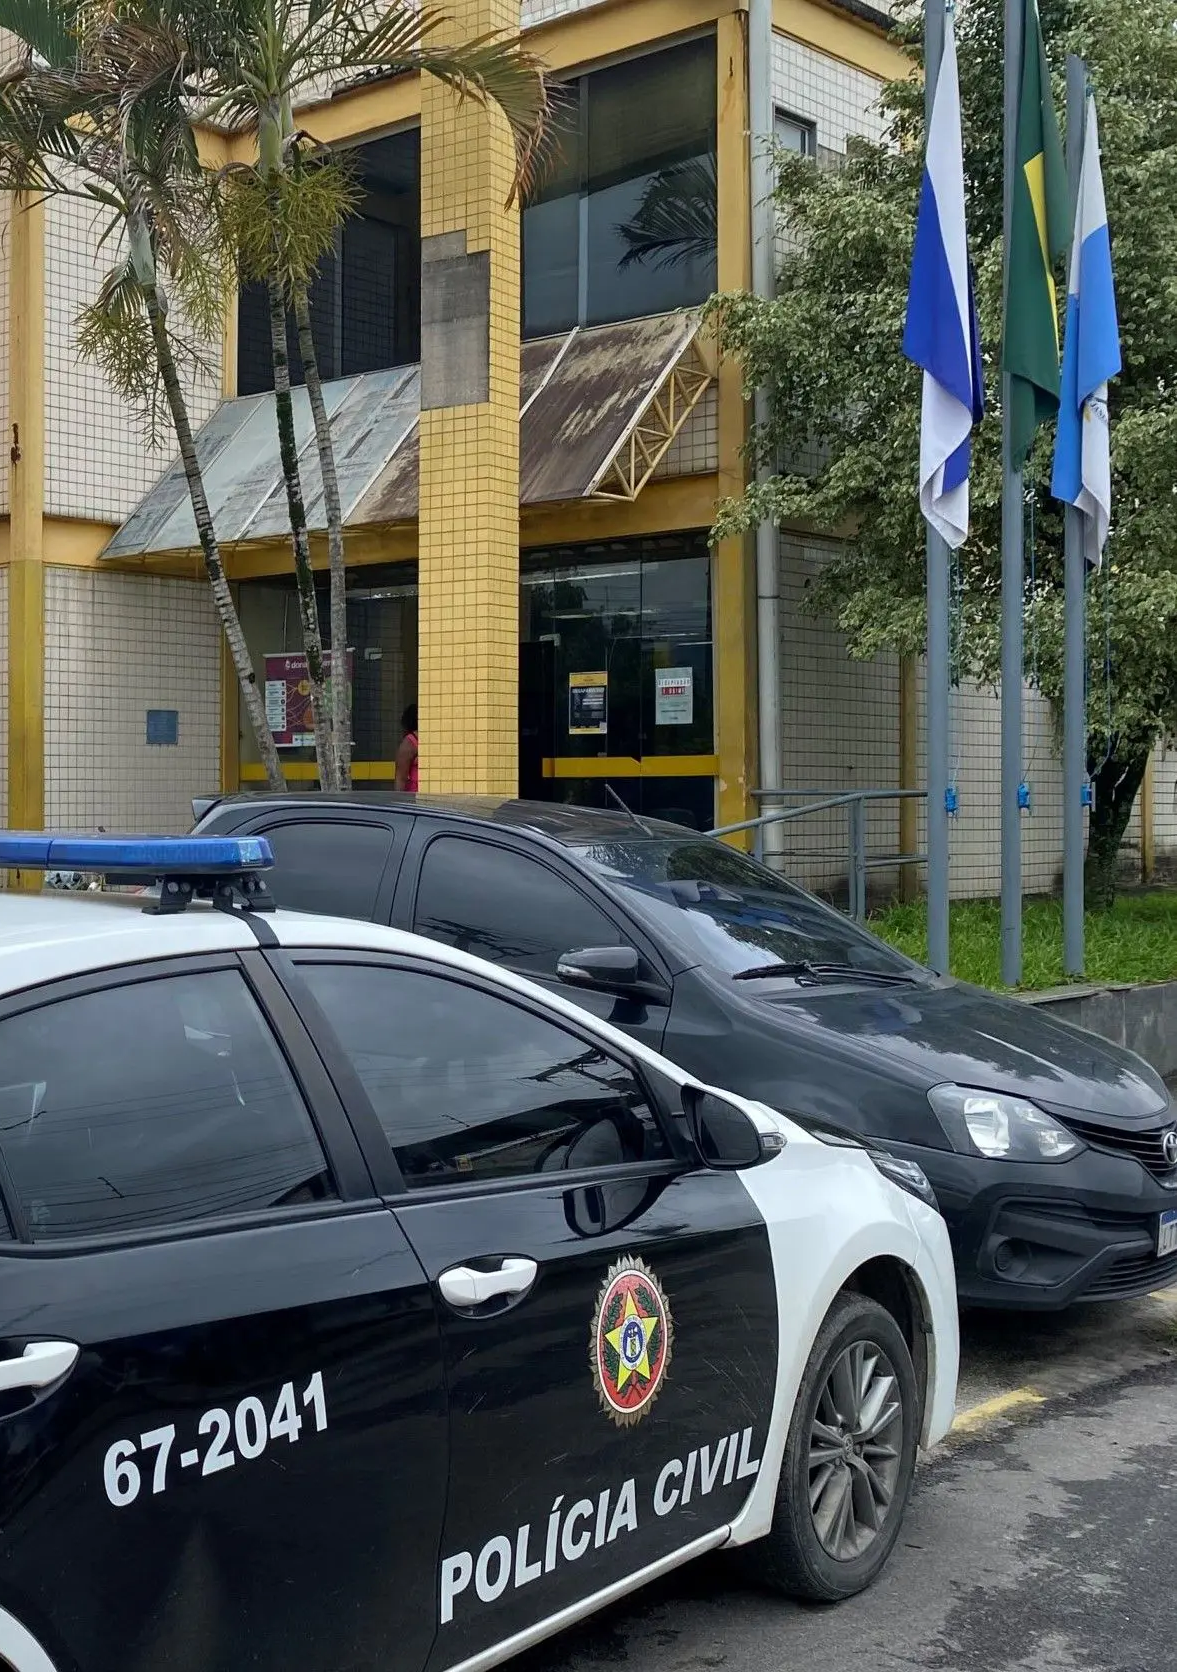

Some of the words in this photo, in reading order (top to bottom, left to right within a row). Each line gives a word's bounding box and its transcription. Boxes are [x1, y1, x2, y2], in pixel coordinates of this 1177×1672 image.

[103, 1370, 328, 1507] 67-2041
[440, 1478, 638, 1625] POLÍCIA
[653, 1426, 760, 1516] CIVIL
